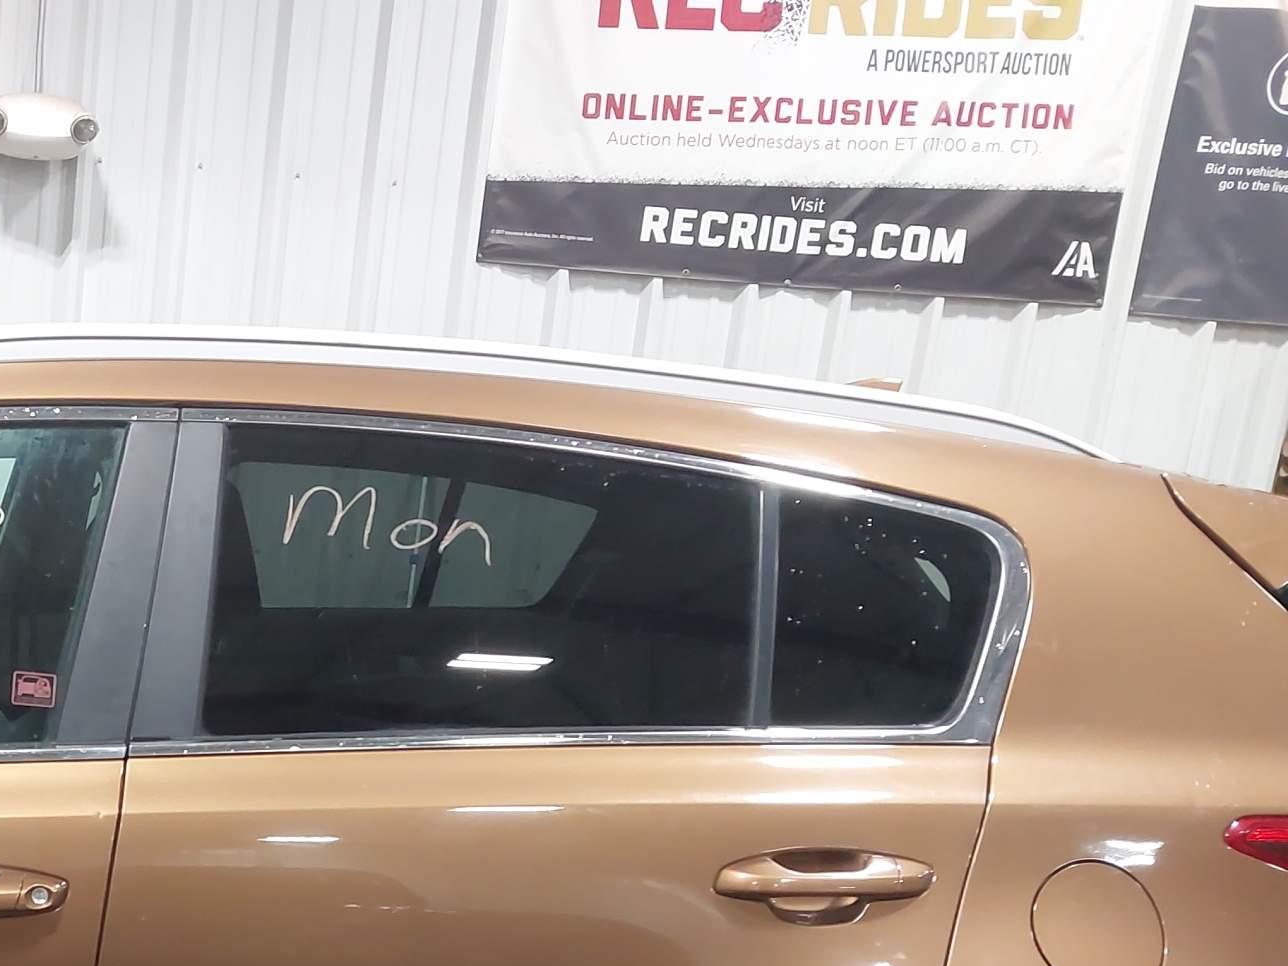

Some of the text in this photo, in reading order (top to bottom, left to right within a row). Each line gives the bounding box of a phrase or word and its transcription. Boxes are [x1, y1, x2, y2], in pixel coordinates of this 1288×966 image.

[867, 49, 1072, 76] A POWERSPORT AUCTION
[581, 92, 1075, 130] ONLINE-EXCLUSIVE AUCTION
[606, 131, 671, 147] Auction
[676, 132, 713, 148] held
[718, 133, 820, 153] Wednesdays
[825, 138, 841, 151] at
[847, 139, 889, 152] noon
[895, 137, 918, 152] ET
[922, 137, 967, 154] (11:00
[971, 141, 1004, 153] a.m.
[1196, 135, 1283, 157] Exclusive
[1204, 162, 1226, 175] Bid
[1227, 166, 1244, 176] on
[1218, 180, 1235, 192] go
[1237, 180, 1249, 190] to
[1251, 180, 1270, 192] the
[790, 196, 826, 213] Visit
[639, 205, 968, 264] RECRIDES.COM
